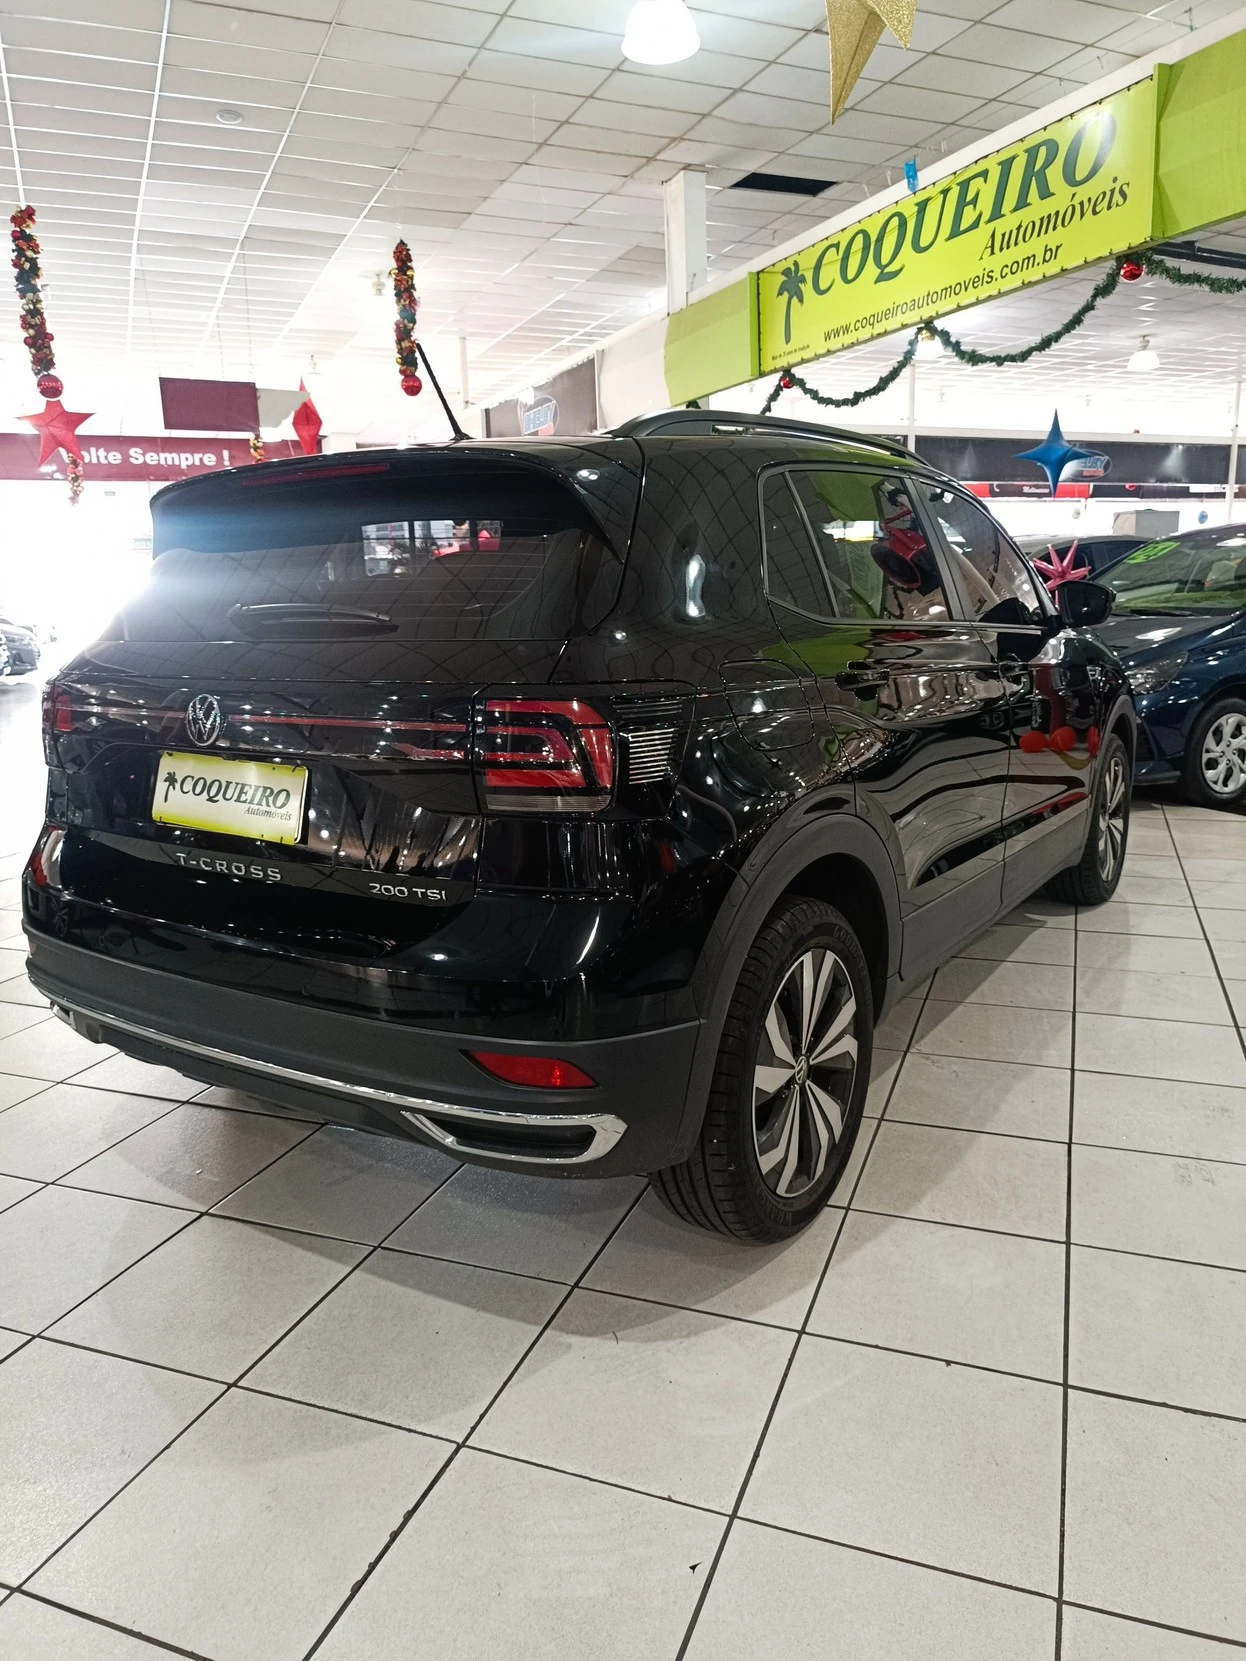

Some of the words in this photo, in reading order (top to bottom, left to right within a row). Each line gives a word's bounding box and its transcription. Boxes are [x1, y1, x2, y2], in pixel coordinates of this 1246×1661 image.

[812, 112, 1118, 294] COQUEIRO
[979, 176, 1131, 261] Automóveis
[823, 243, 1063, 343] www.coqueiroautomoveis.com.br
[129, 447, 217, 469] Sempre
[179, 774, 291, 810] COQUEIRO
[243, 805, 293, 822] Automóveis
[175, 852, 284, 882] T-CROSS
[368, 882, 409, 899] 200
[413, 887, 448, 902] TSI
